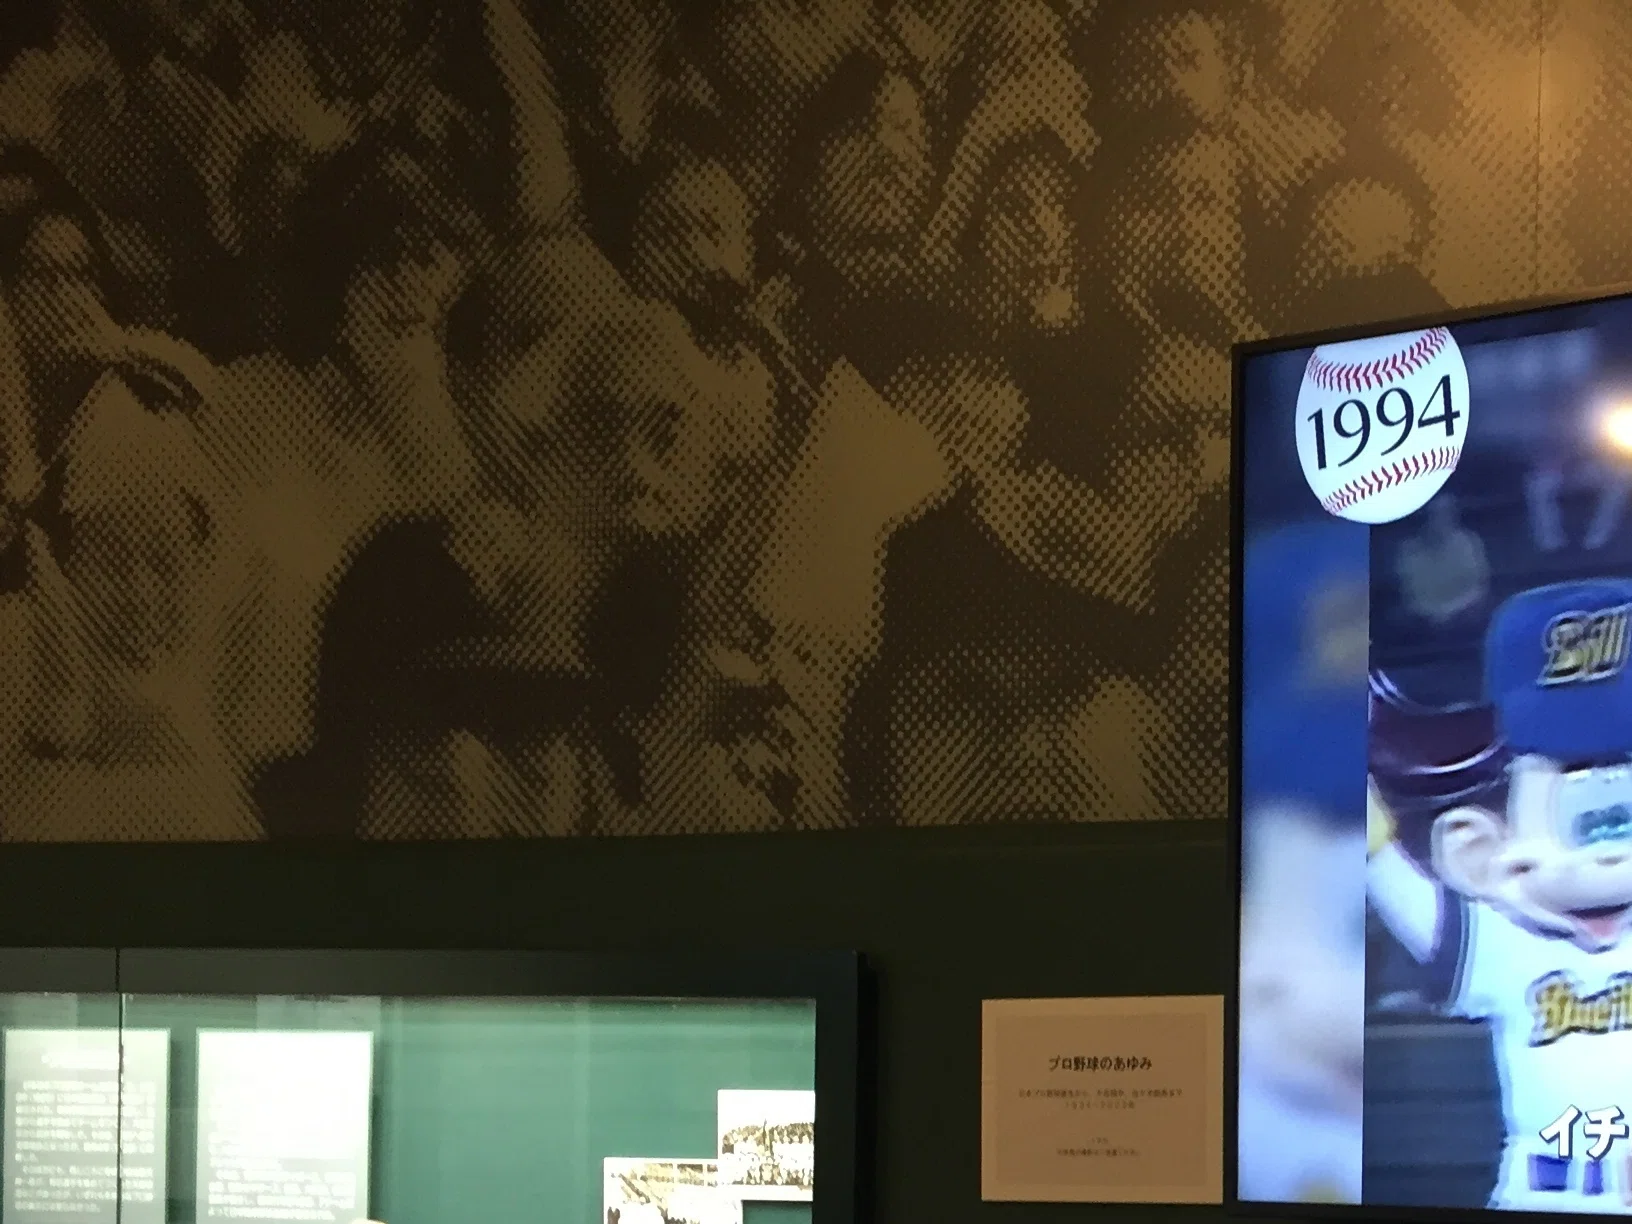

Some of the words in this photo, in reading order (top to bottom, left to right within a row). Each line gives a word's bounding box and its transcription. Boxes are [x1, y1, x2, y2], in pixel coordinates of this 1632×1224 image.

[1306, 373, 1461, 471] 1994
[1048, 1054, 1153, 1073] プロ野球のあゆみ
